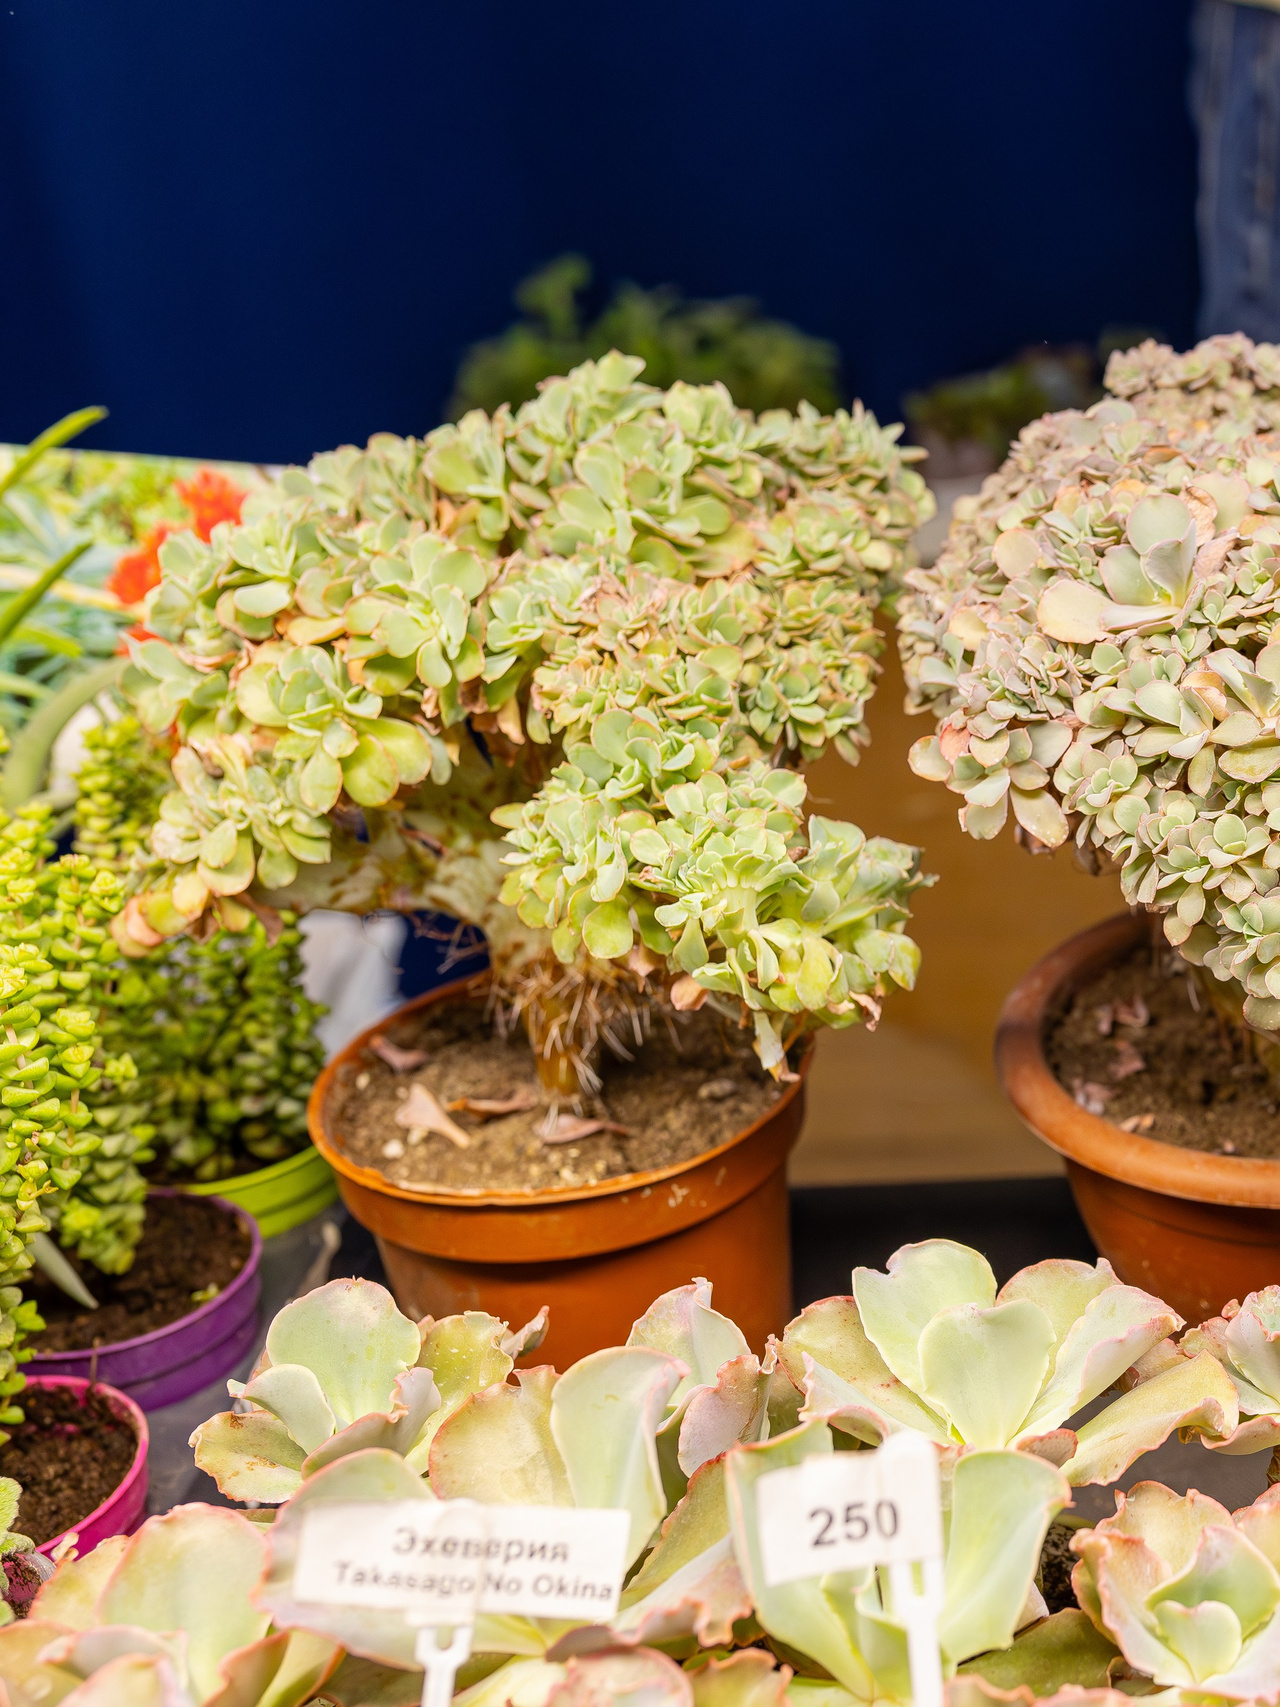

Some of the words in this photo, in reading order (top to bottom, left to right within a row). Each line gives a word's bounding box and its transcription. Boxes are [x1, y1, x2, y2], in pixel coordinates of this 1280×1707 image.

[809, 1499, 900, 1549] 250
[392, 1526, 570, 1564] Эхеверия
[334, 1560, 475, 1598] Takasago
[480, 1572, 522, 1596] No
[532, 1573, 615, 1601] Okina
